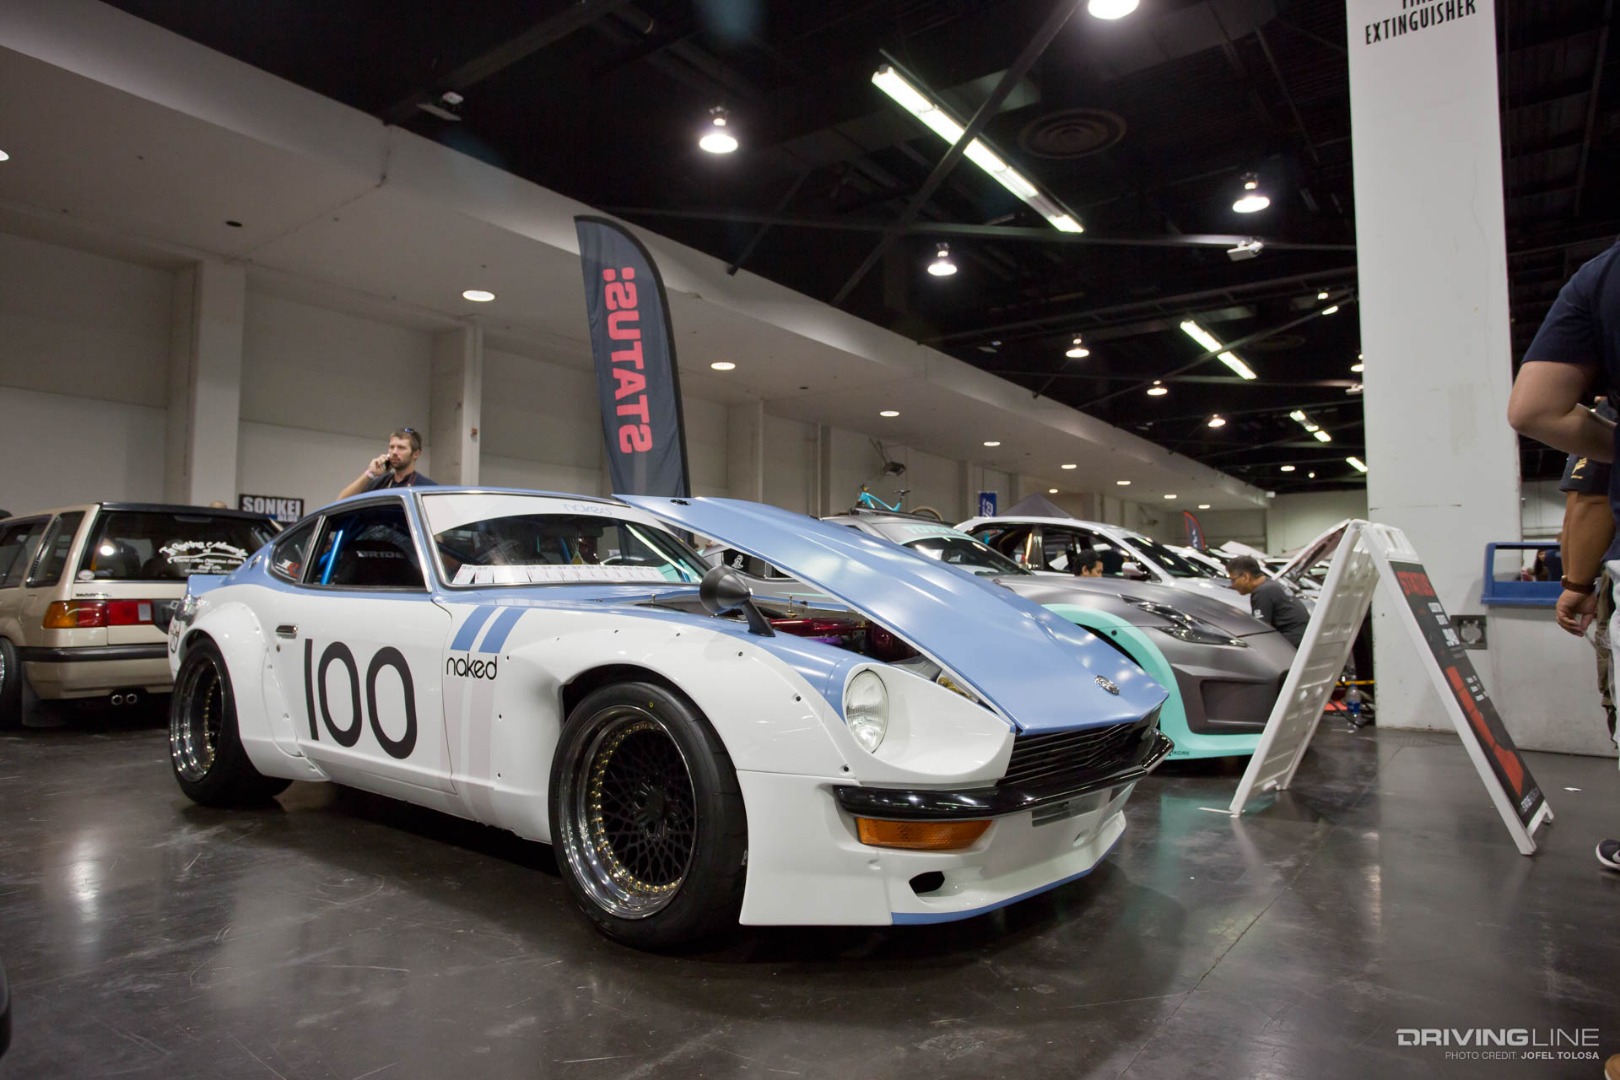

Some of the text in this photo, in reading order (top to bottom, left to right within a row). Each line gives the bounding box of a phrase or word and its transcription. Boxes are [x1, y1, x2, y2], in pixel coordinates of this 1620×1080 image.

[1365, 0, 1476, 45] EXTINGUISHER
[242, 496, 301, 515] SONKEI
[446, 653, 498, 680] naked
[304, 638, 418, 759] 100
